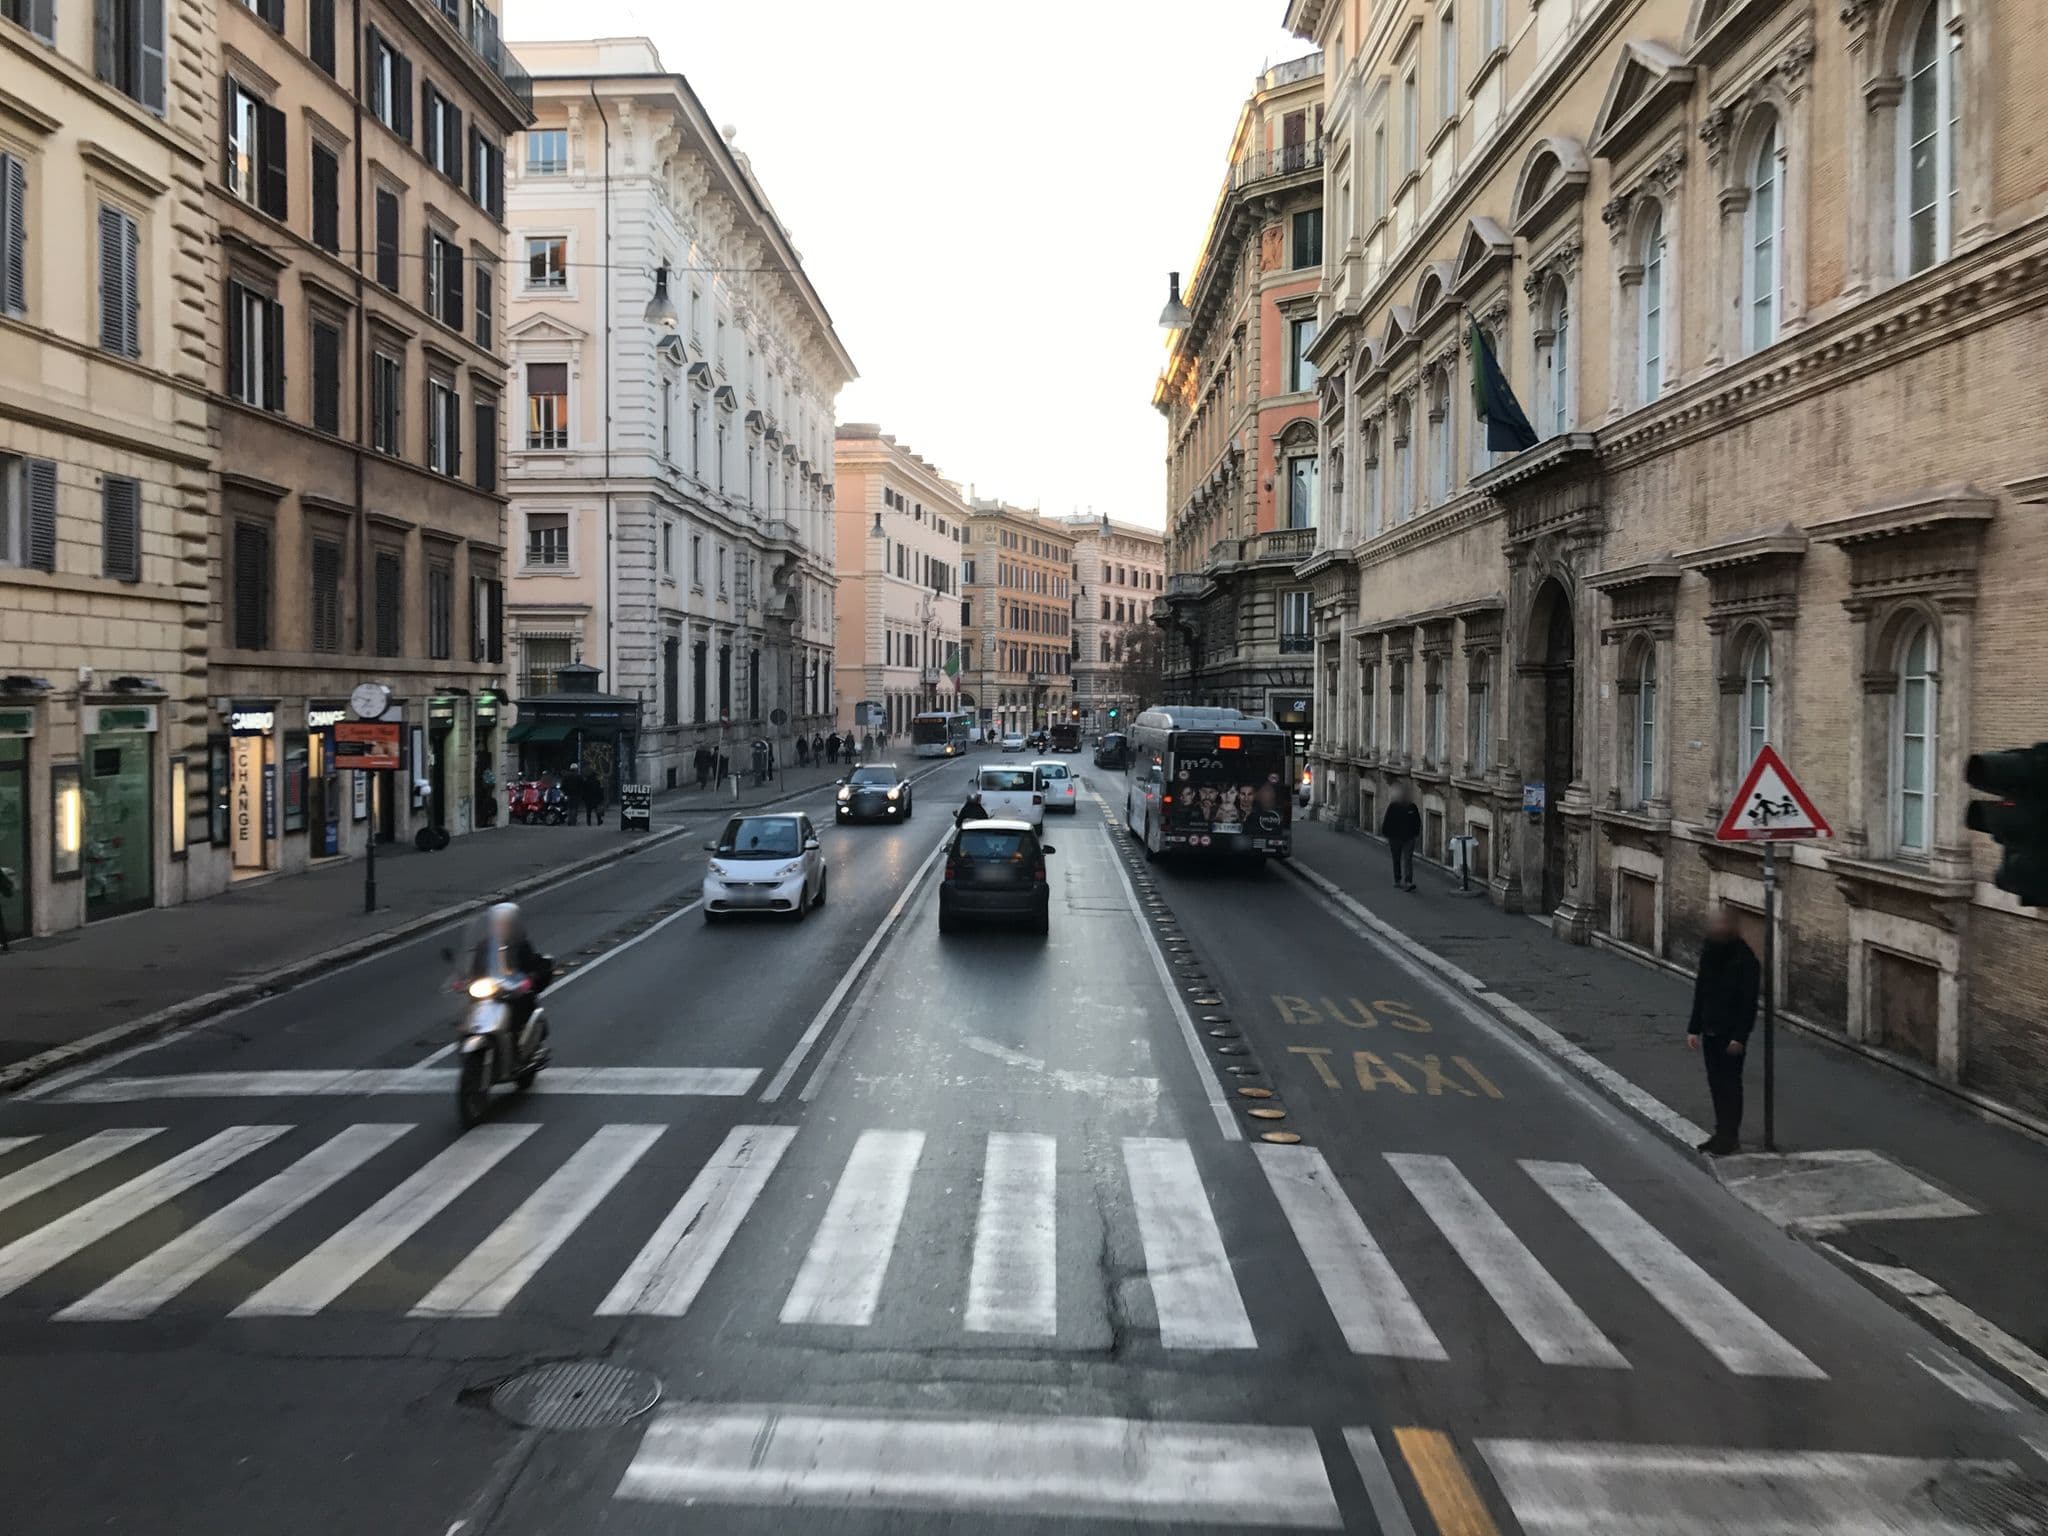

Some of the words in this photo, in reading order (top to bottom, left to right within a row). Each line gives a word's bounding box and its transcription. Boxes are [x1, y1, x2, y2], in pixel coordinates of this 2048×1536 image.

[238, 755, 249, 841] CHANGE
[622, 784, 651, 794] OUTLET
[1271, 994, 1433, 1033] BUS
[1287, 1046, 1505, 1099] TAXI
